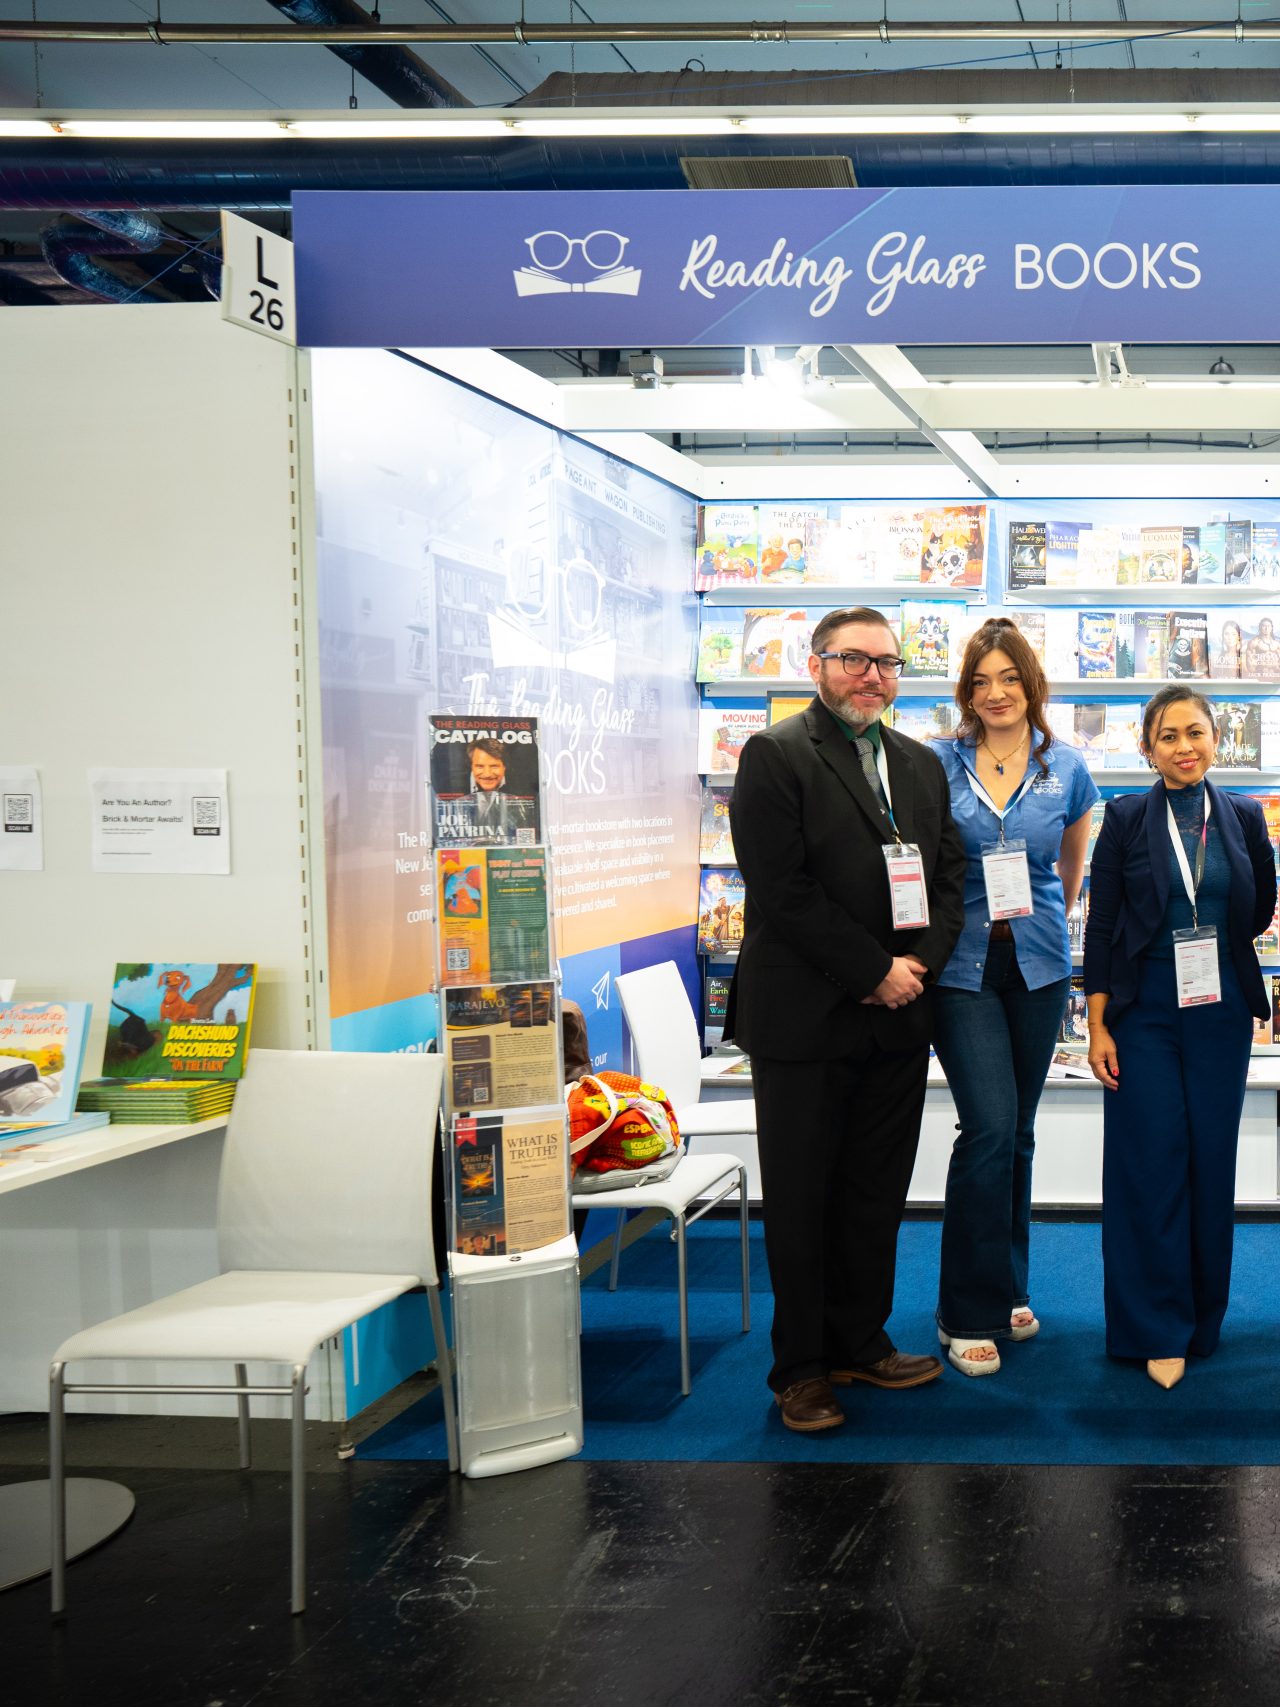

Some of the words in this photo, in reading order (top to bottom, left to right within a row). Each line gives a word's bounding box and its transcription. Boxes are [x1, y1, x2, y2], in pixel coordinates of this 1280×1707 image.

[256, 235, 279, 290] L
[679, 234, 853, 317] Reading
[866, 231, 987, 317] Glass
[1015, 242, 1202, 290] BOOKS
[249, 290, 284, 331] 26
[456, 721, 498, 729] READING
[722, 713, 767, 723] MOVING
[434, 729, 533, 744] CATALOG
[102, 815, 122, 823] Brick
[131, 815, 155, 823] Mortar
[437, 815, 469, 826] JOE
[439, 825, 505, 838] PATRINA
[397, 831, 418, 848] The
[395, 858, 420, 874] New
[448, 998, 506, 1011] SARAJEVO
[710, 1006, 727, 1014] Wate
[167, 1025, 240, 1041] DACHSHUND
[161, 1042, 239, 1057] DISCOVERIES
[507, 1135, 544, 1149] WHAT
[546, 1133, 558, 1144] IS
[509, 1145, 558, 1160] TRUTH?
